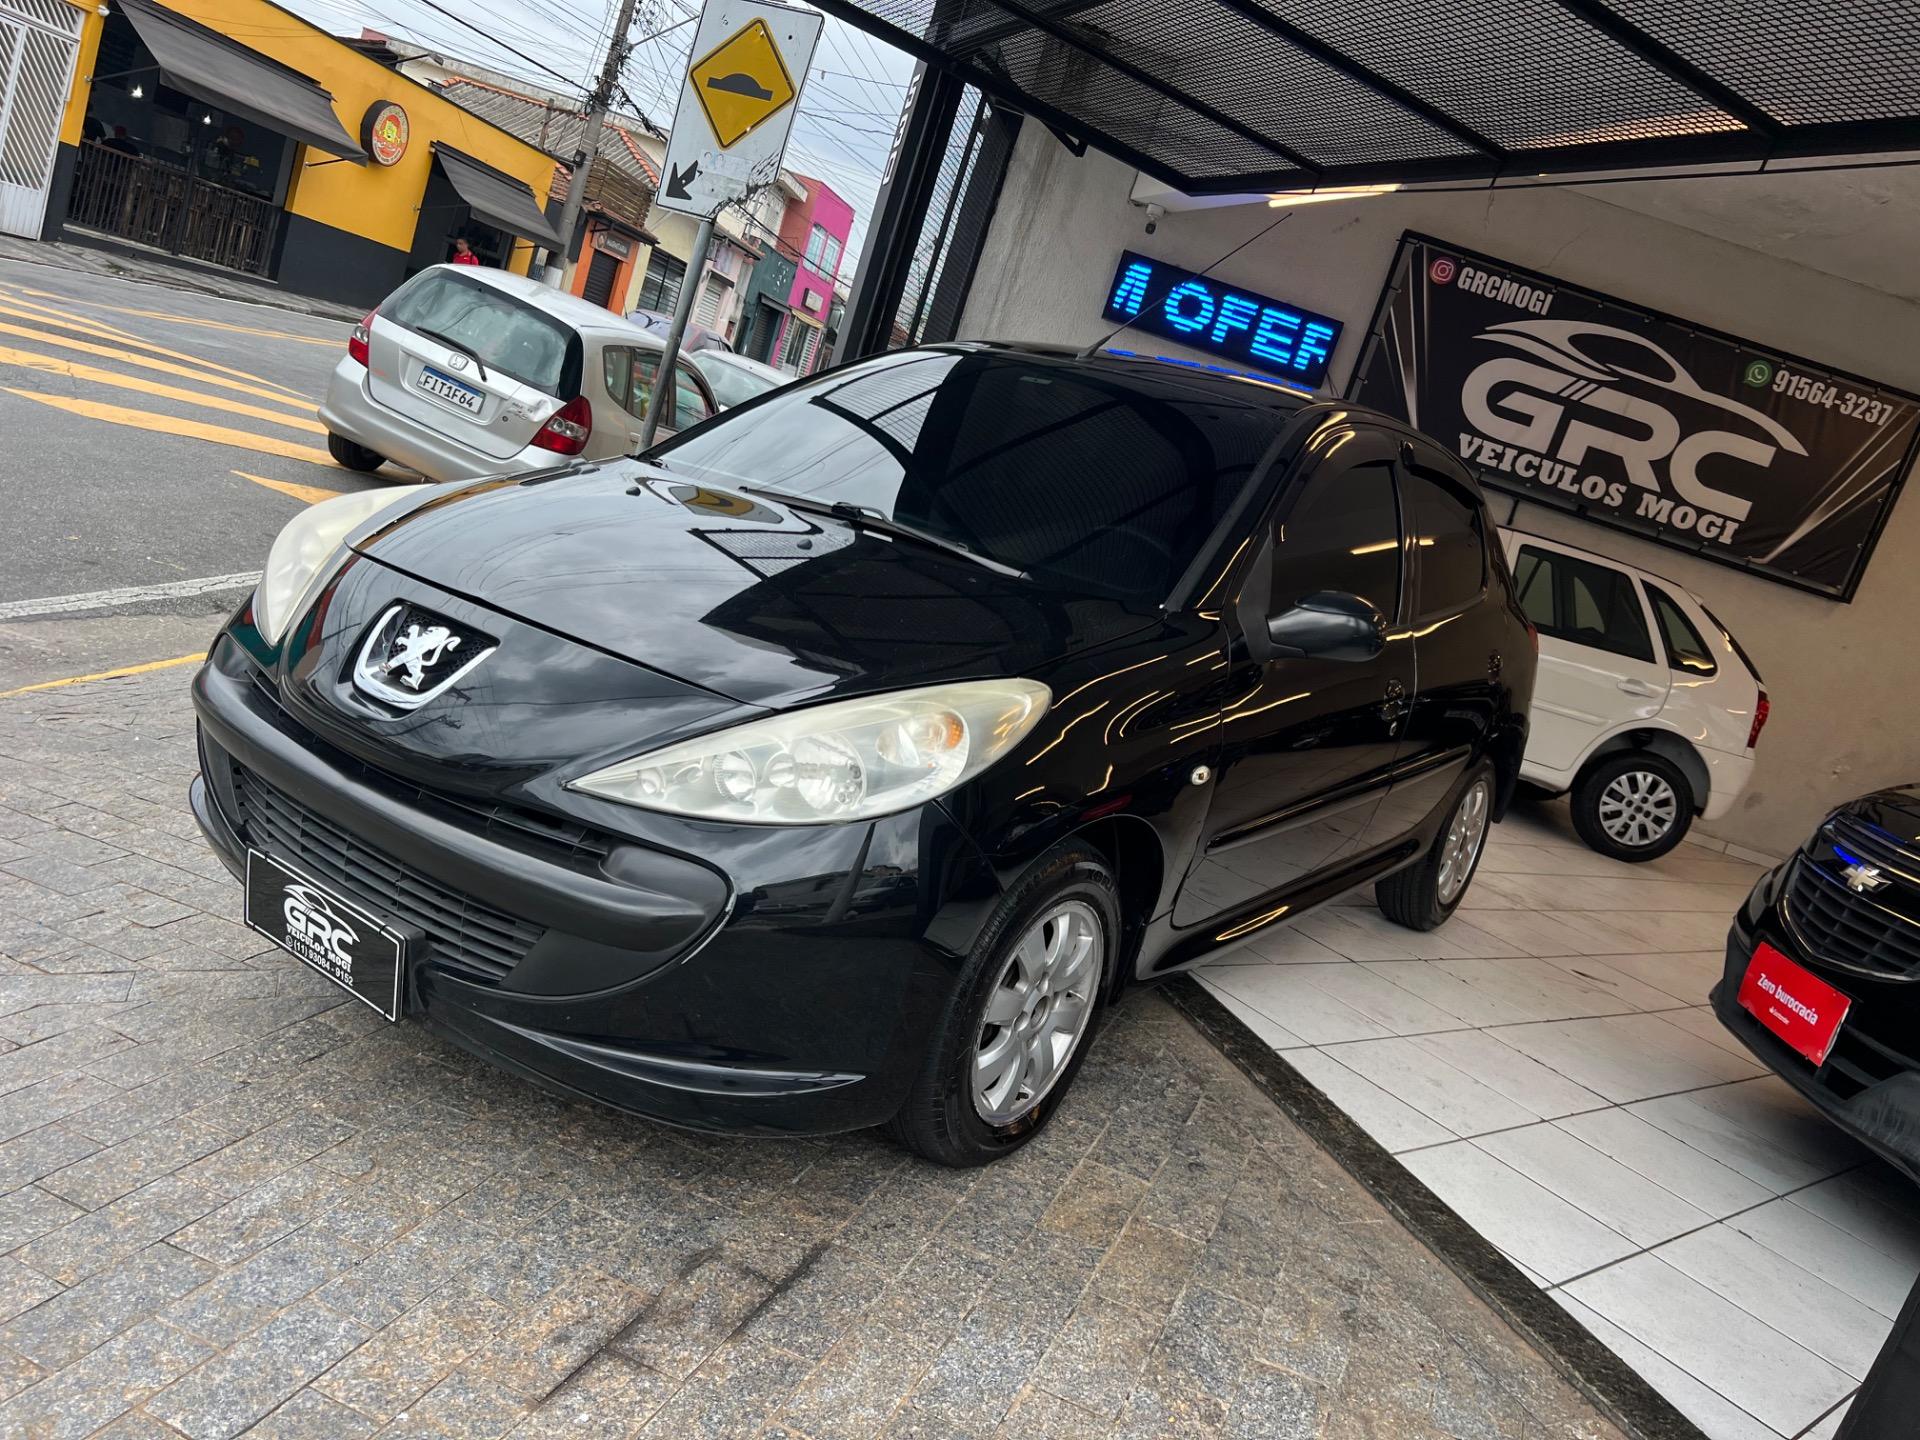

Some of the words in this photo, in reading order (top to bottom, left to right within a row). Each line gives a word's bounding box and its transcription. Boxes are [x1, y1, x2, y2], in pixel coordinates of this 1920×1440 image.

[1456, 266, 1554, 316] GRCMOGI
[422, 374, 476, 408] FIT1F64
[1771, 369, 1894, 428] 91564-3237
[1461, 357, 1778, 522] GRC
[1457, 432, 1628, 508] VEICULOS
[1635, 491, 1741, 545] MOGI
[283, 896, 354, 965] GRC
[285, 922, 326, 955] VEICULOS
[327, 949, 352, 974] MOGI
[1756, 972, 1776, 996] Zero
[1775, 984, 1819, 1026] burocracia
